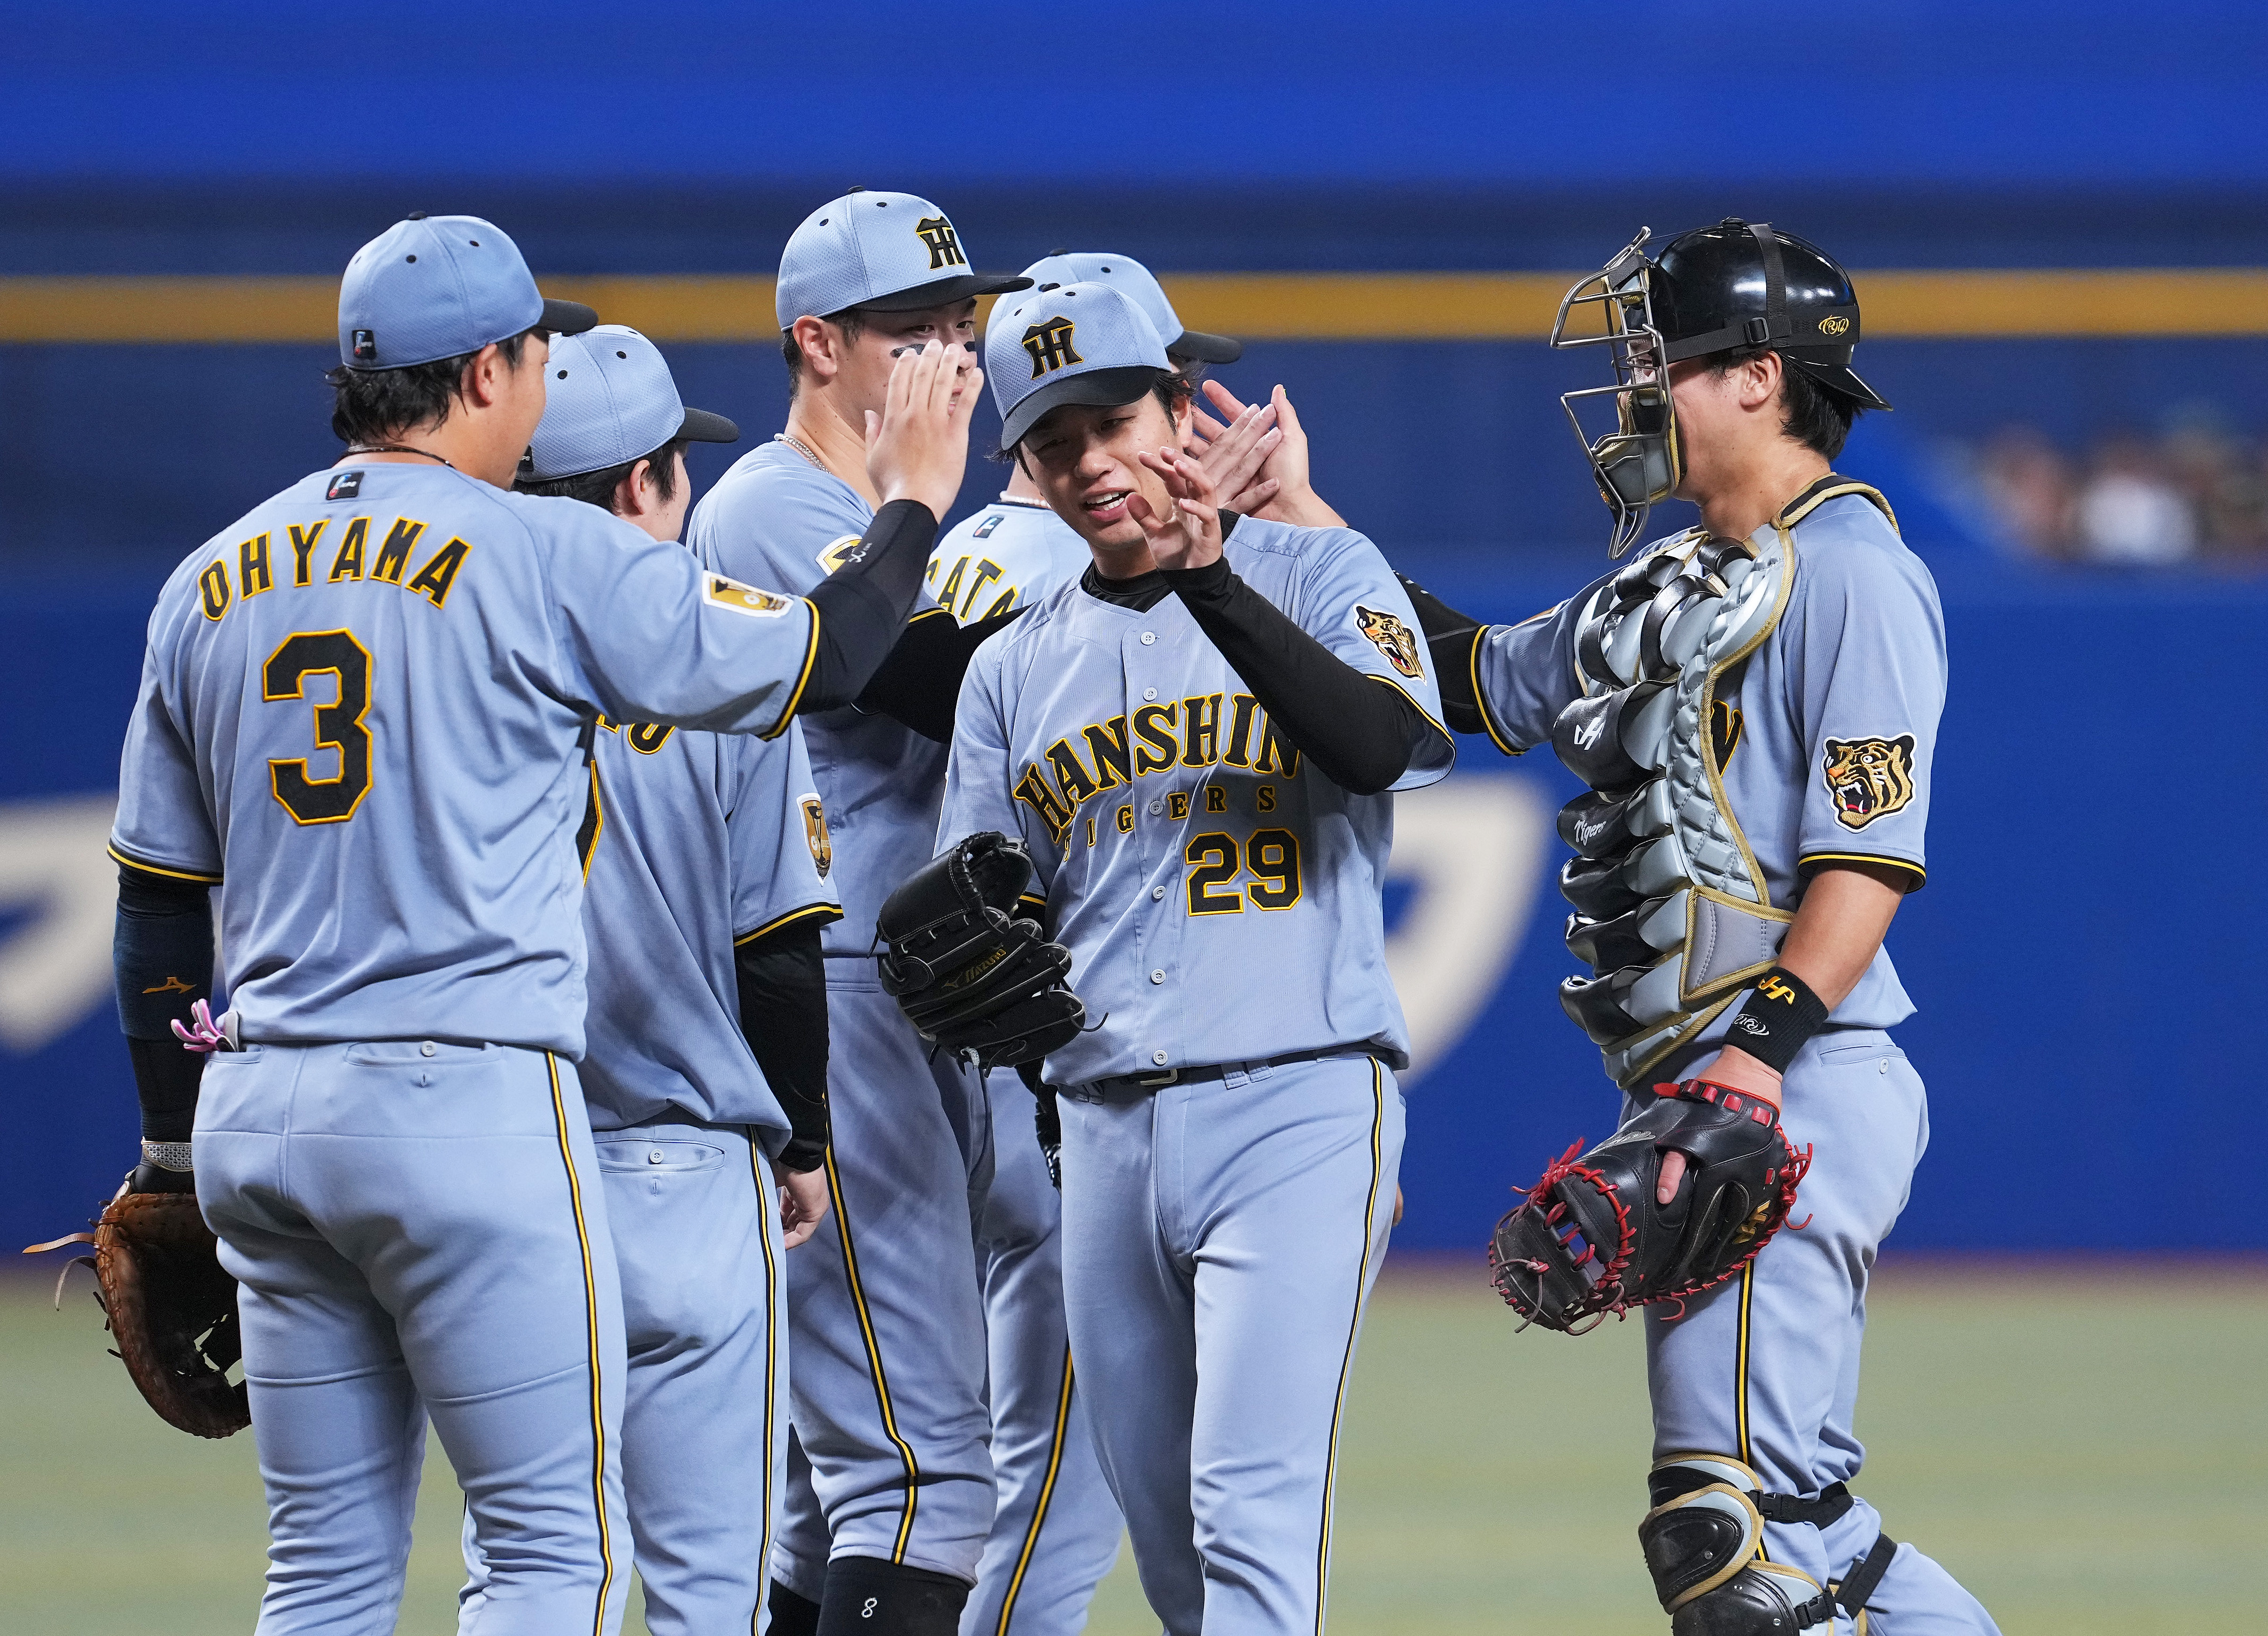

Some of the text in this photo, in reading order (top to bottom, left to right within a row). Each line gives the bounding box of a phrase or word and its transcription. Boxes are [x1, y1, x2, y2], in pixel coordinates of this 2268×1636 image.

[199, 516, 473, 622] OHYAMA
[262, 627, 374, 827] 3
[1013, 692, 1301, 847] HANSHIN
[1185, 828, 1302, 917] 29
[1574, 820, 1606, 846] Tigers
[861, 1598, 877, 1618] 8
